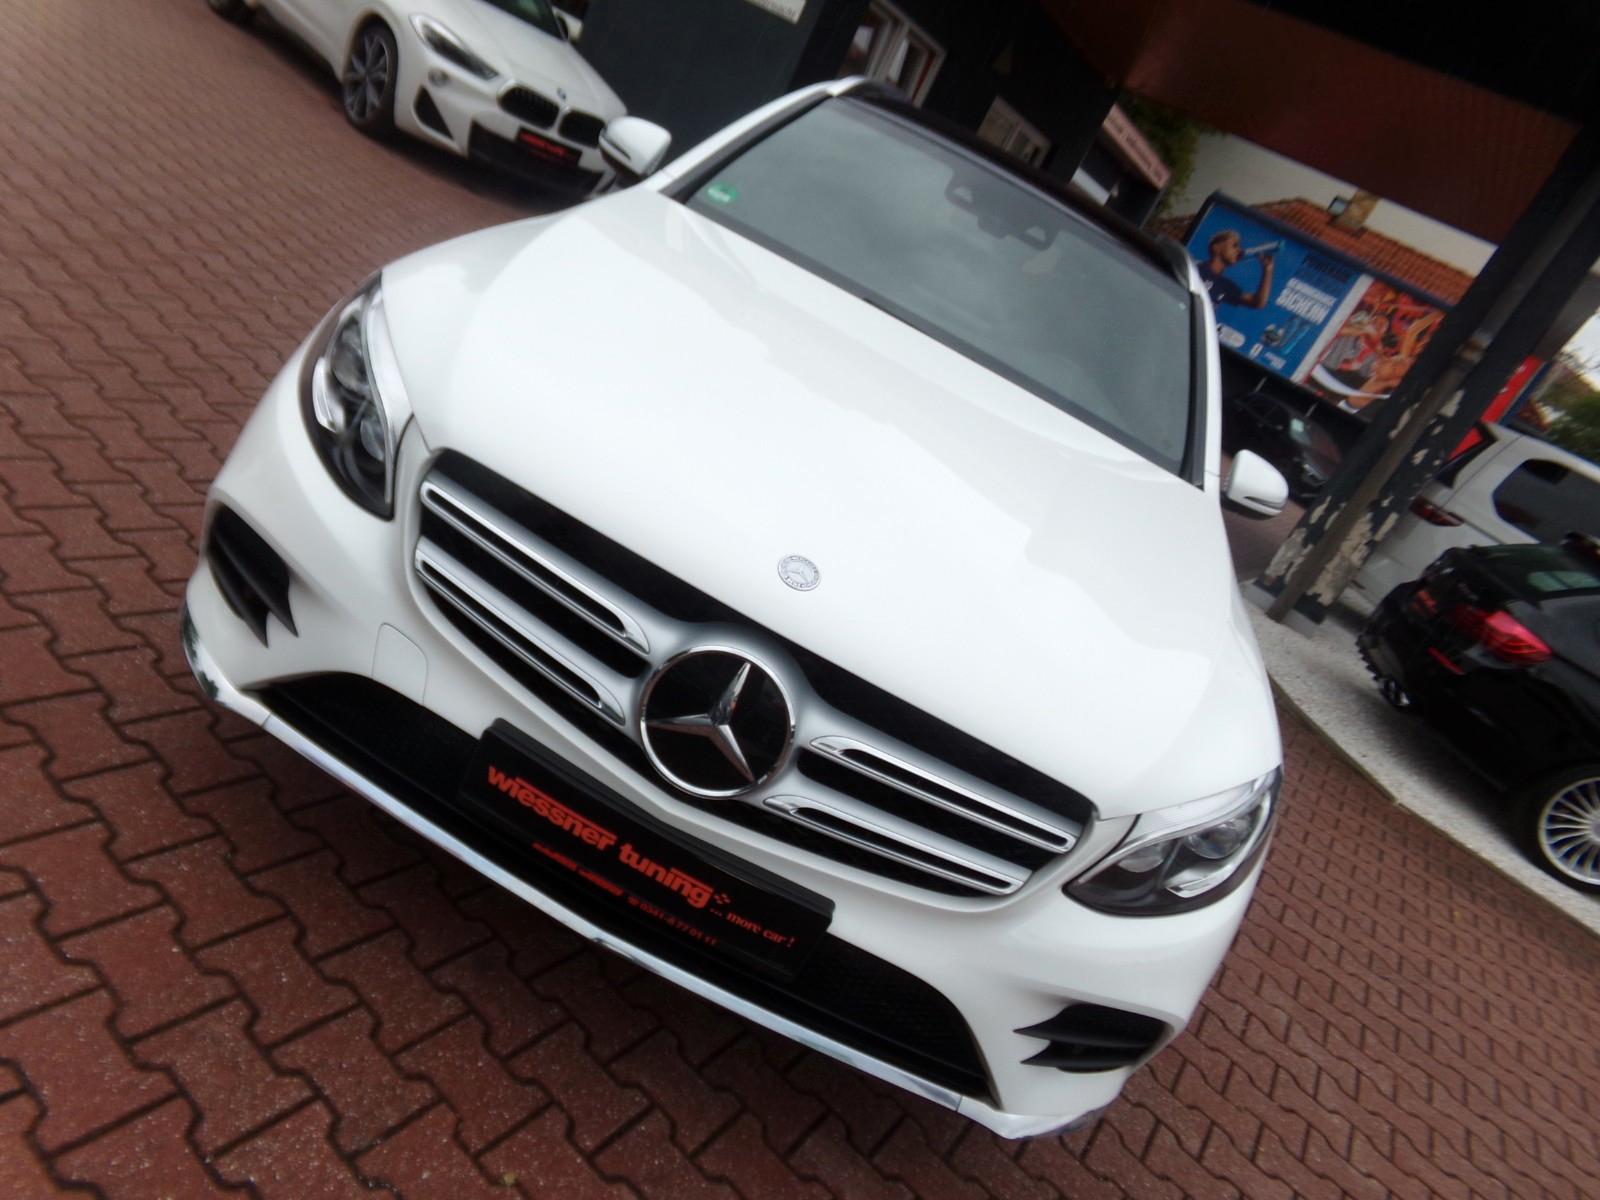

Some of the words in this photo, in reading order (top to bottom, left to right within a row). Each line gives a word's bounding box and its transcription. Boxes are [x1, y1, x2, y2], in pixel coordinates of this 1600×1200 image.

[488, 766, 617, 850] wiessner
[619, 843, 713, 908] tuning
[727, 912, 761, 933] more
